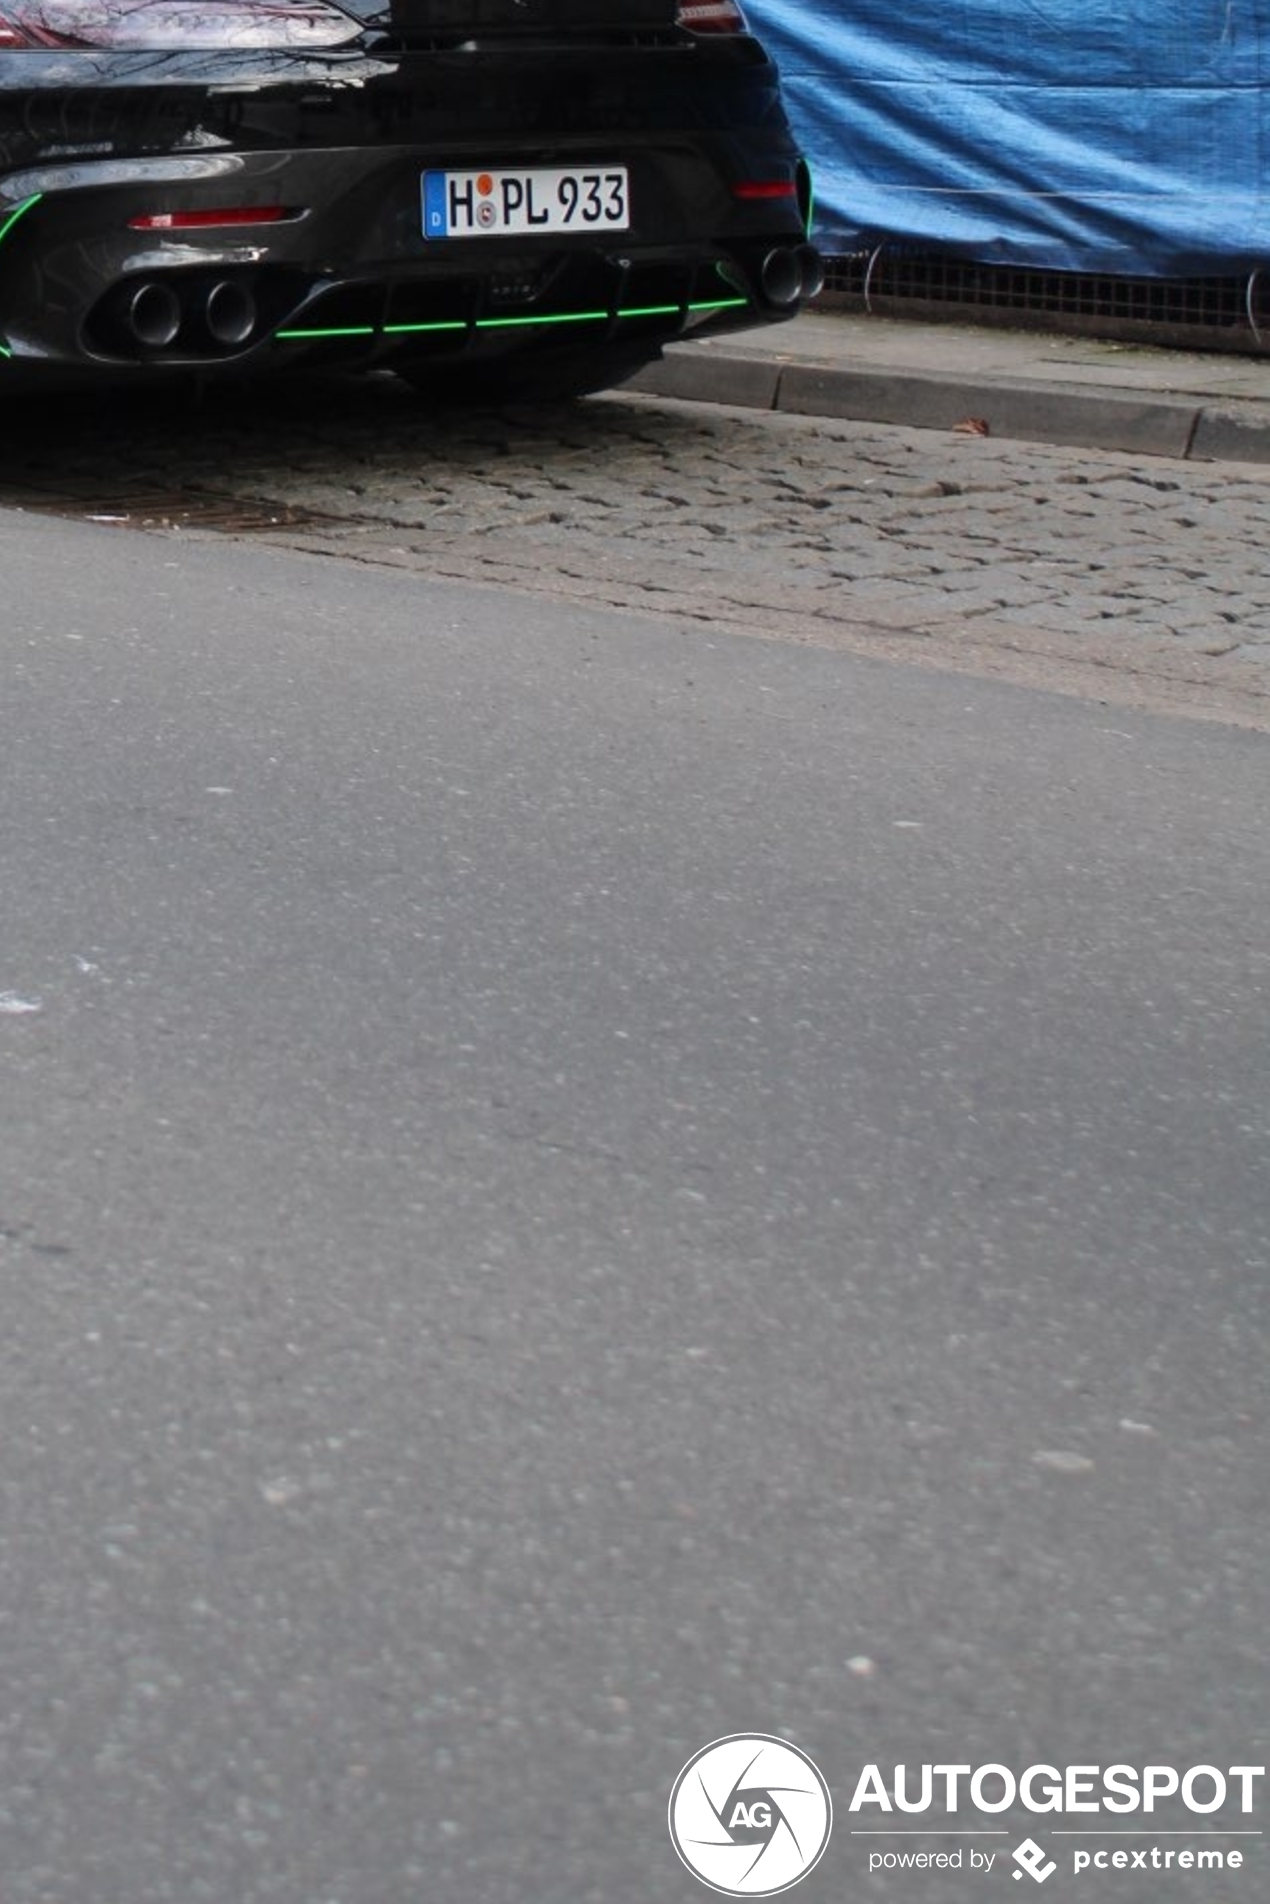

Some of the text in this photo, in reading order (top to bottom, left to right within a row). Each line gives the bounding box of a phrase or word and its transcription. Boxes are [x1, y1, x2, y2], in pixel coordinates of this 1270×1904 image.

[431, 174, 624, 227] D H PL 933
